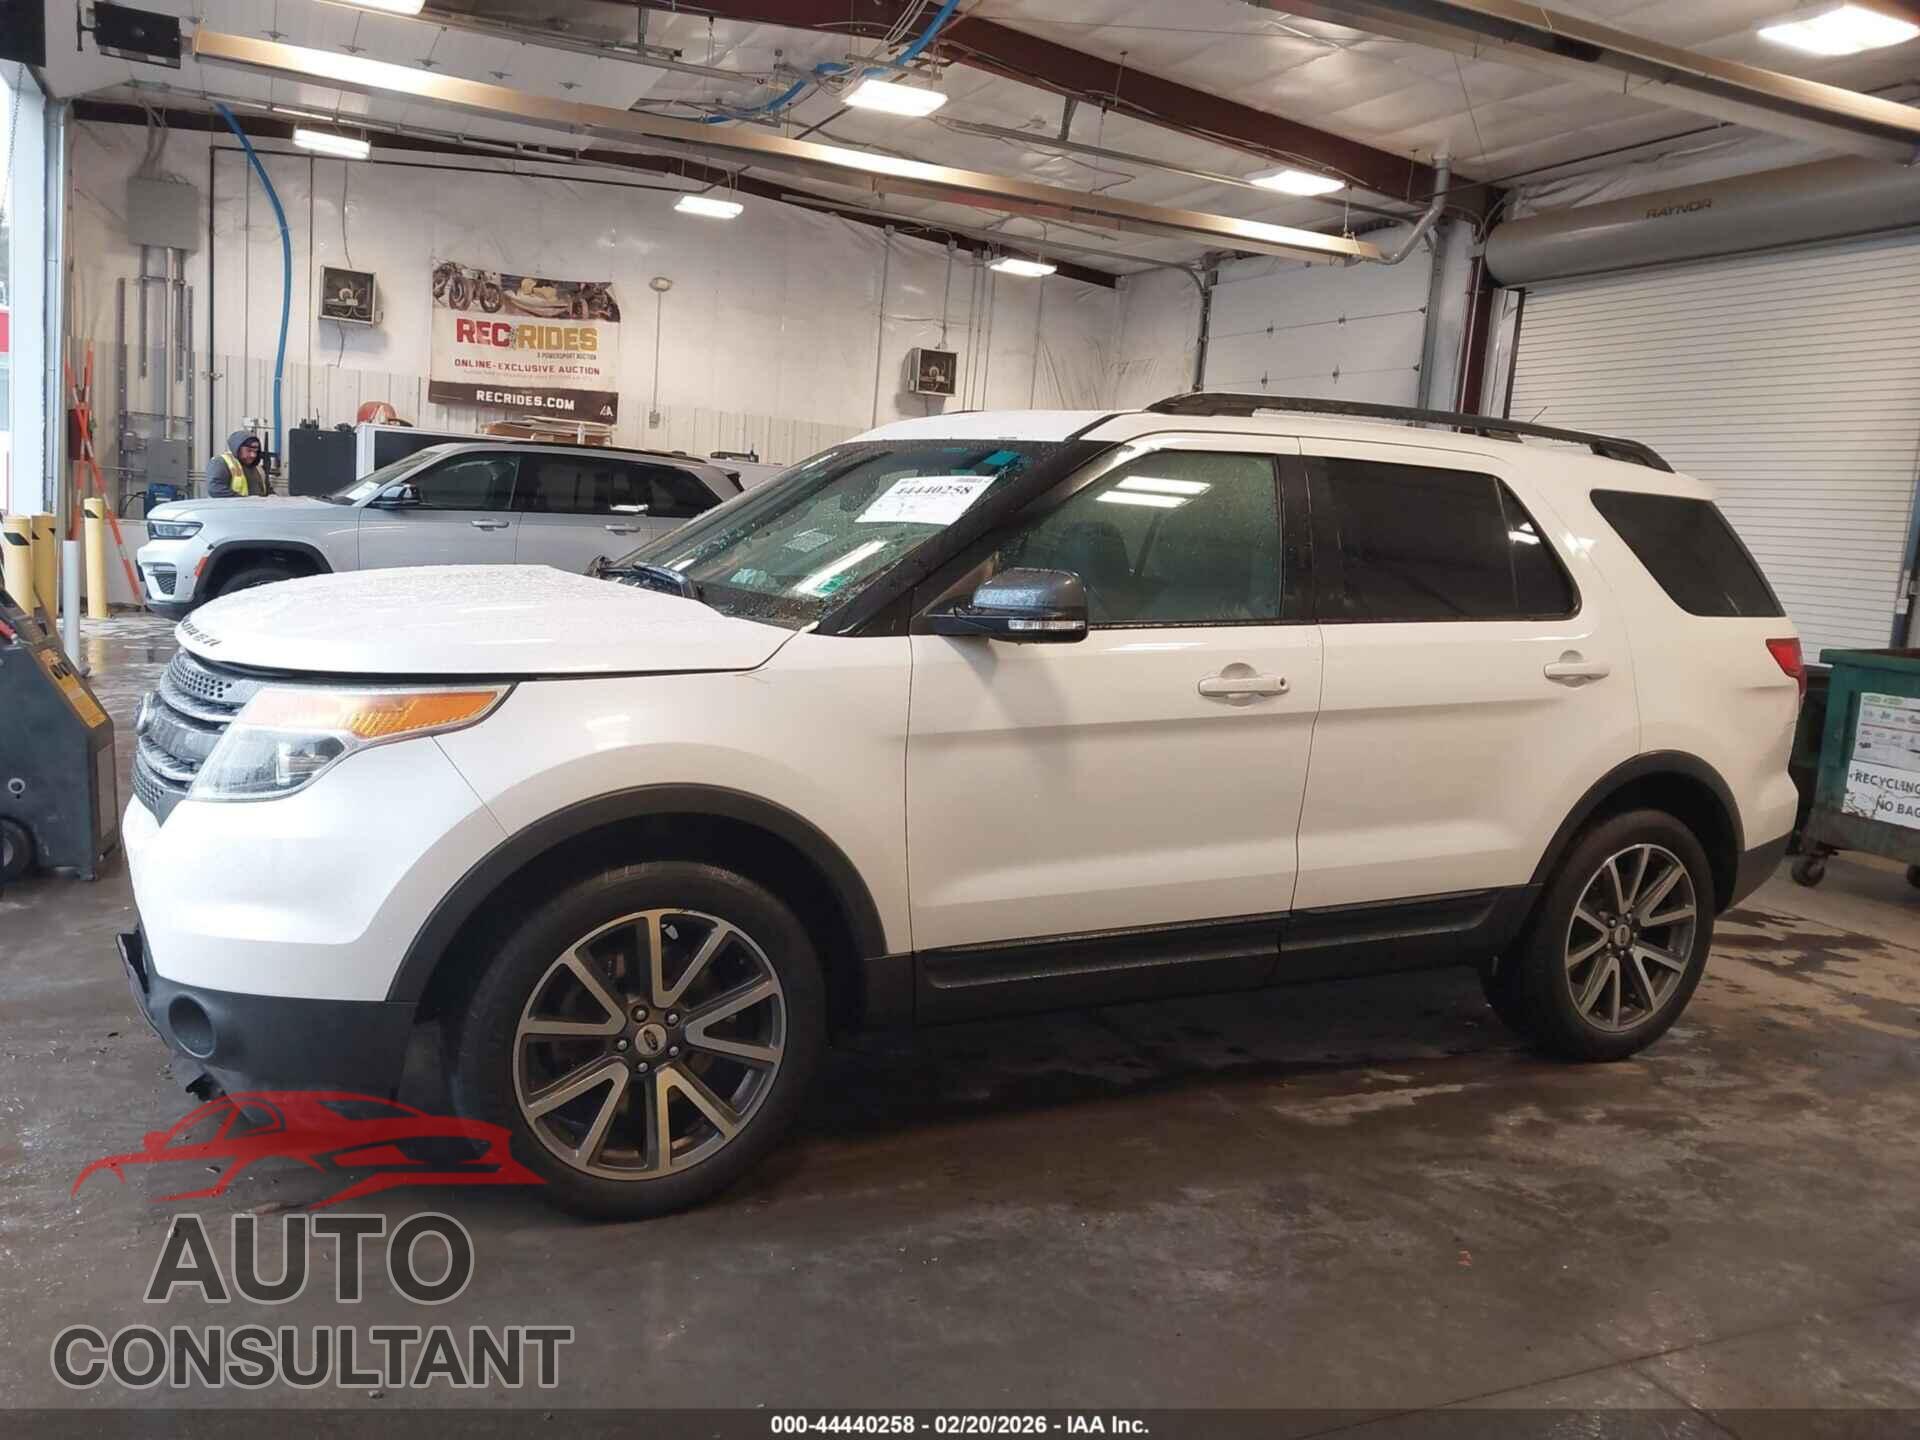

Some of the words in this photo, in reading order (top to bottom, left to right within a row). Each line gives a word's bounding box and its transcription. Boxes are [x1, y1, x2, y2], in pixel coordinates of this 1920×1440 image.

[1645, 199, 1713, 219] RAYNOR
[456, 318, 511, 347] REC
[518, 325, 598, 351] RIDES
[454, 358, 555, 373] ONLINE-EXCLUSIVE
[558, 365, 601, 376] AUCTION
[476, 390, 575, 410] RECRIDES.COM
[1875, 798, 1894, 812] NO
